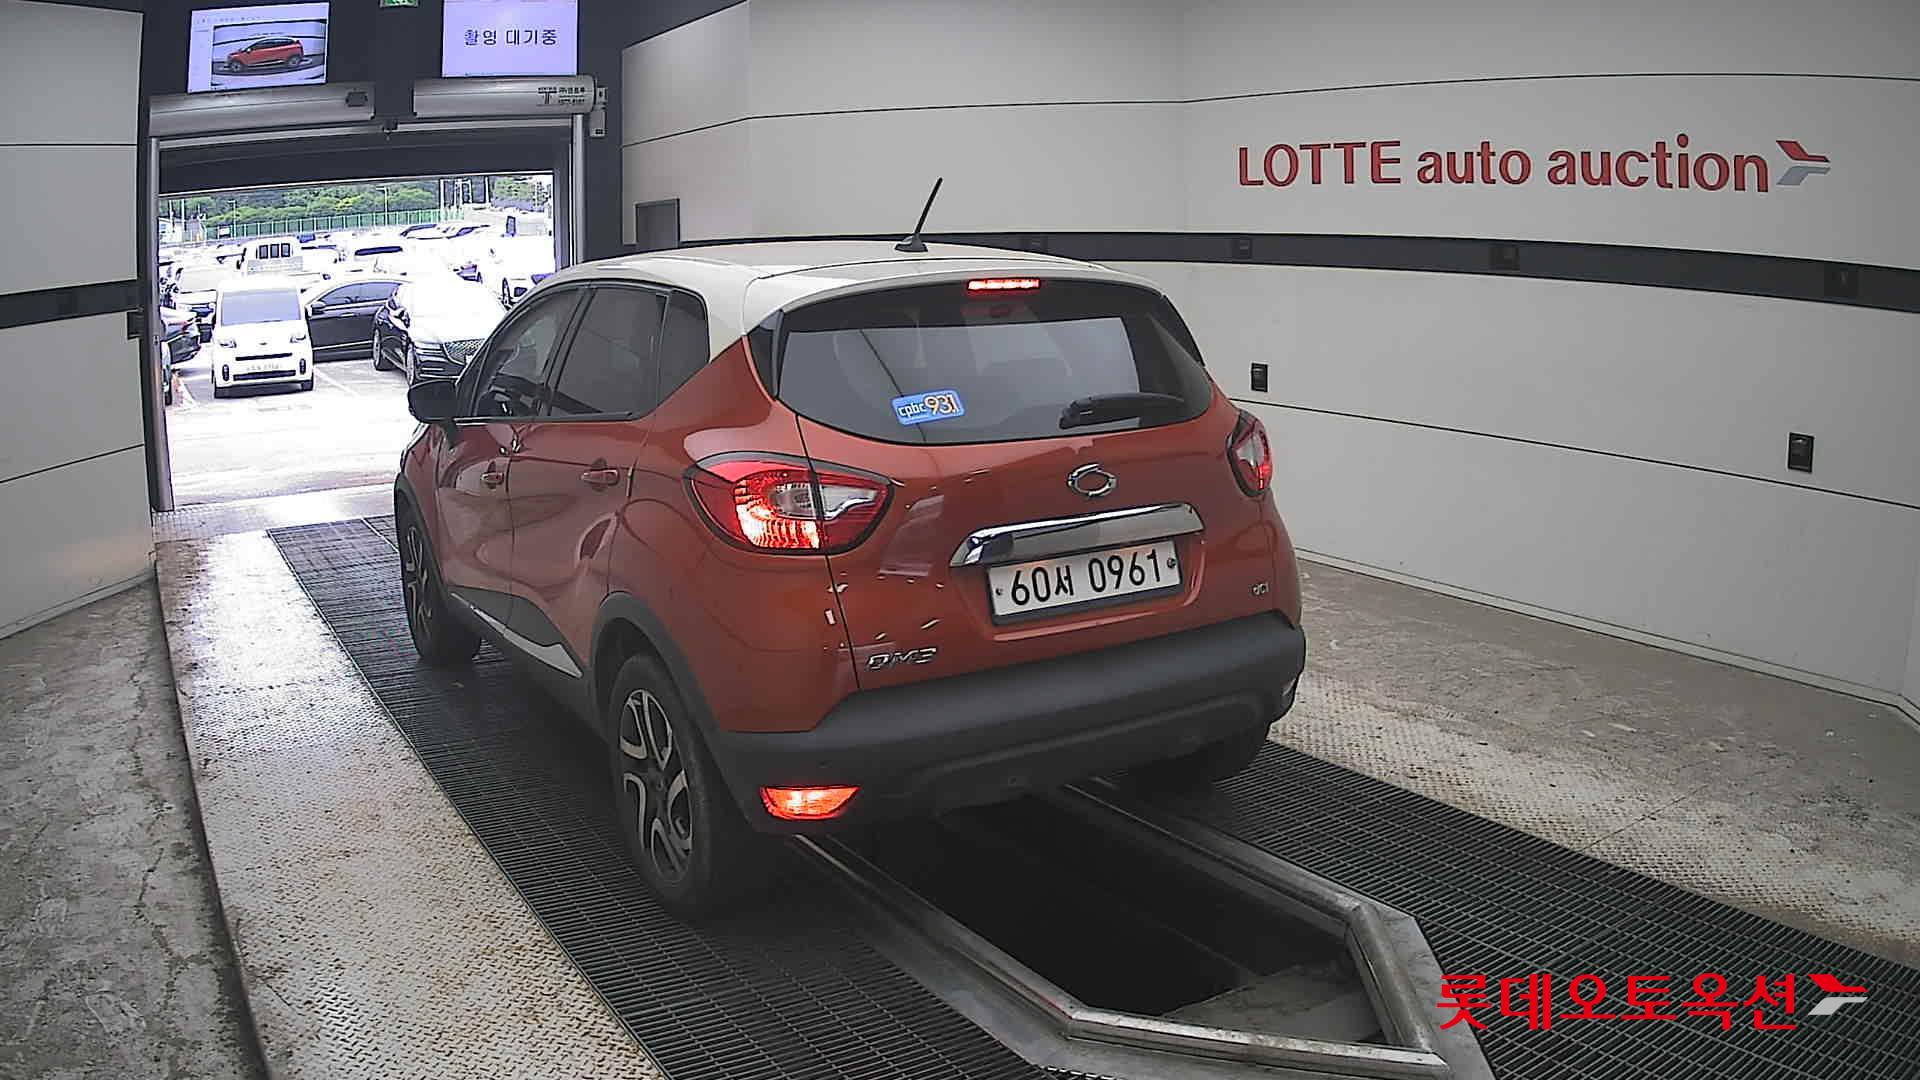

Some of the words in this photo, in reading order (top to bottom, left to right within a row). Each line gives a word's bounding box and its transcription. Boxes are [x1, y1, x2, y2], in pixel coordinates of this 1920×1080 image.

[506, 29, 557, 46] 대기중
[1238, 140, 1401, 187] LOTTE
[1417, 140, 1532, 185] auto
[1547, 133, 1769, 193] auction
[898, 402, 926, 419] cpbc
[1010, 565, 1074, 606] 60서
[1088, 548, 1162, 593] 0961
[866, 647, 937, 672] QM3
